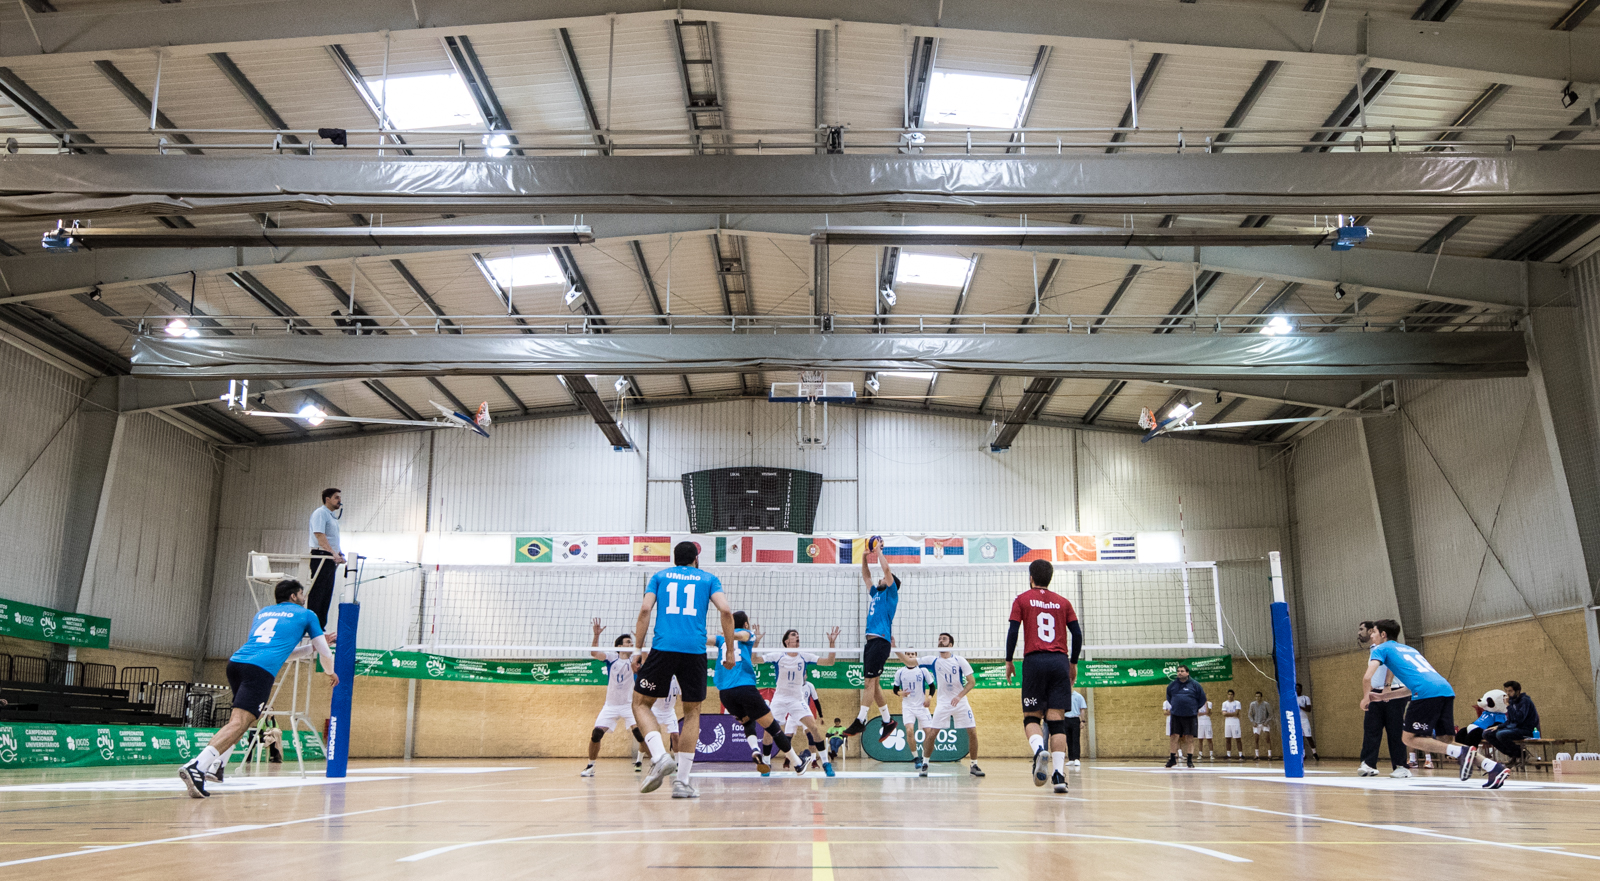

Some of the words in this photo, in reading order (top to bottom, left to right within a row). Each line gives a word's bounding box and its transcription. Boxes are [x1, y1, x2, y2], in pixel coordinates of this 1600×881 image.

[665, 572, 701, 581] UMinho
[666, 582, 697, 616] 11
[1030, 600, 1061, 609] UMinho
[258, 611, 294, 620] UMinho
[40, 616, 56, 630] CNU
[1037, 612, 1055, 643] 8
[253, 618, 279, 644] 4
[426, 660, 446, 670] CNU
[798, 663, 802, 671] 5
[952, 666, 957, 674] 6
[531, 667, 550, 675] CNU
[1163, 666, 1177, 675] CN
[914, 729, 958, 743] OOS
[1285, 710, 1299, 755] AFFSPORTS
[97, 735, 114, 750] CNU
[158, 739, 171, 747] JOGOS
[176, 736, 190, 749] CNU
[328, 716, 337, 760] AFFSPORTS
[75, 739, 89, 748] JOGOS
